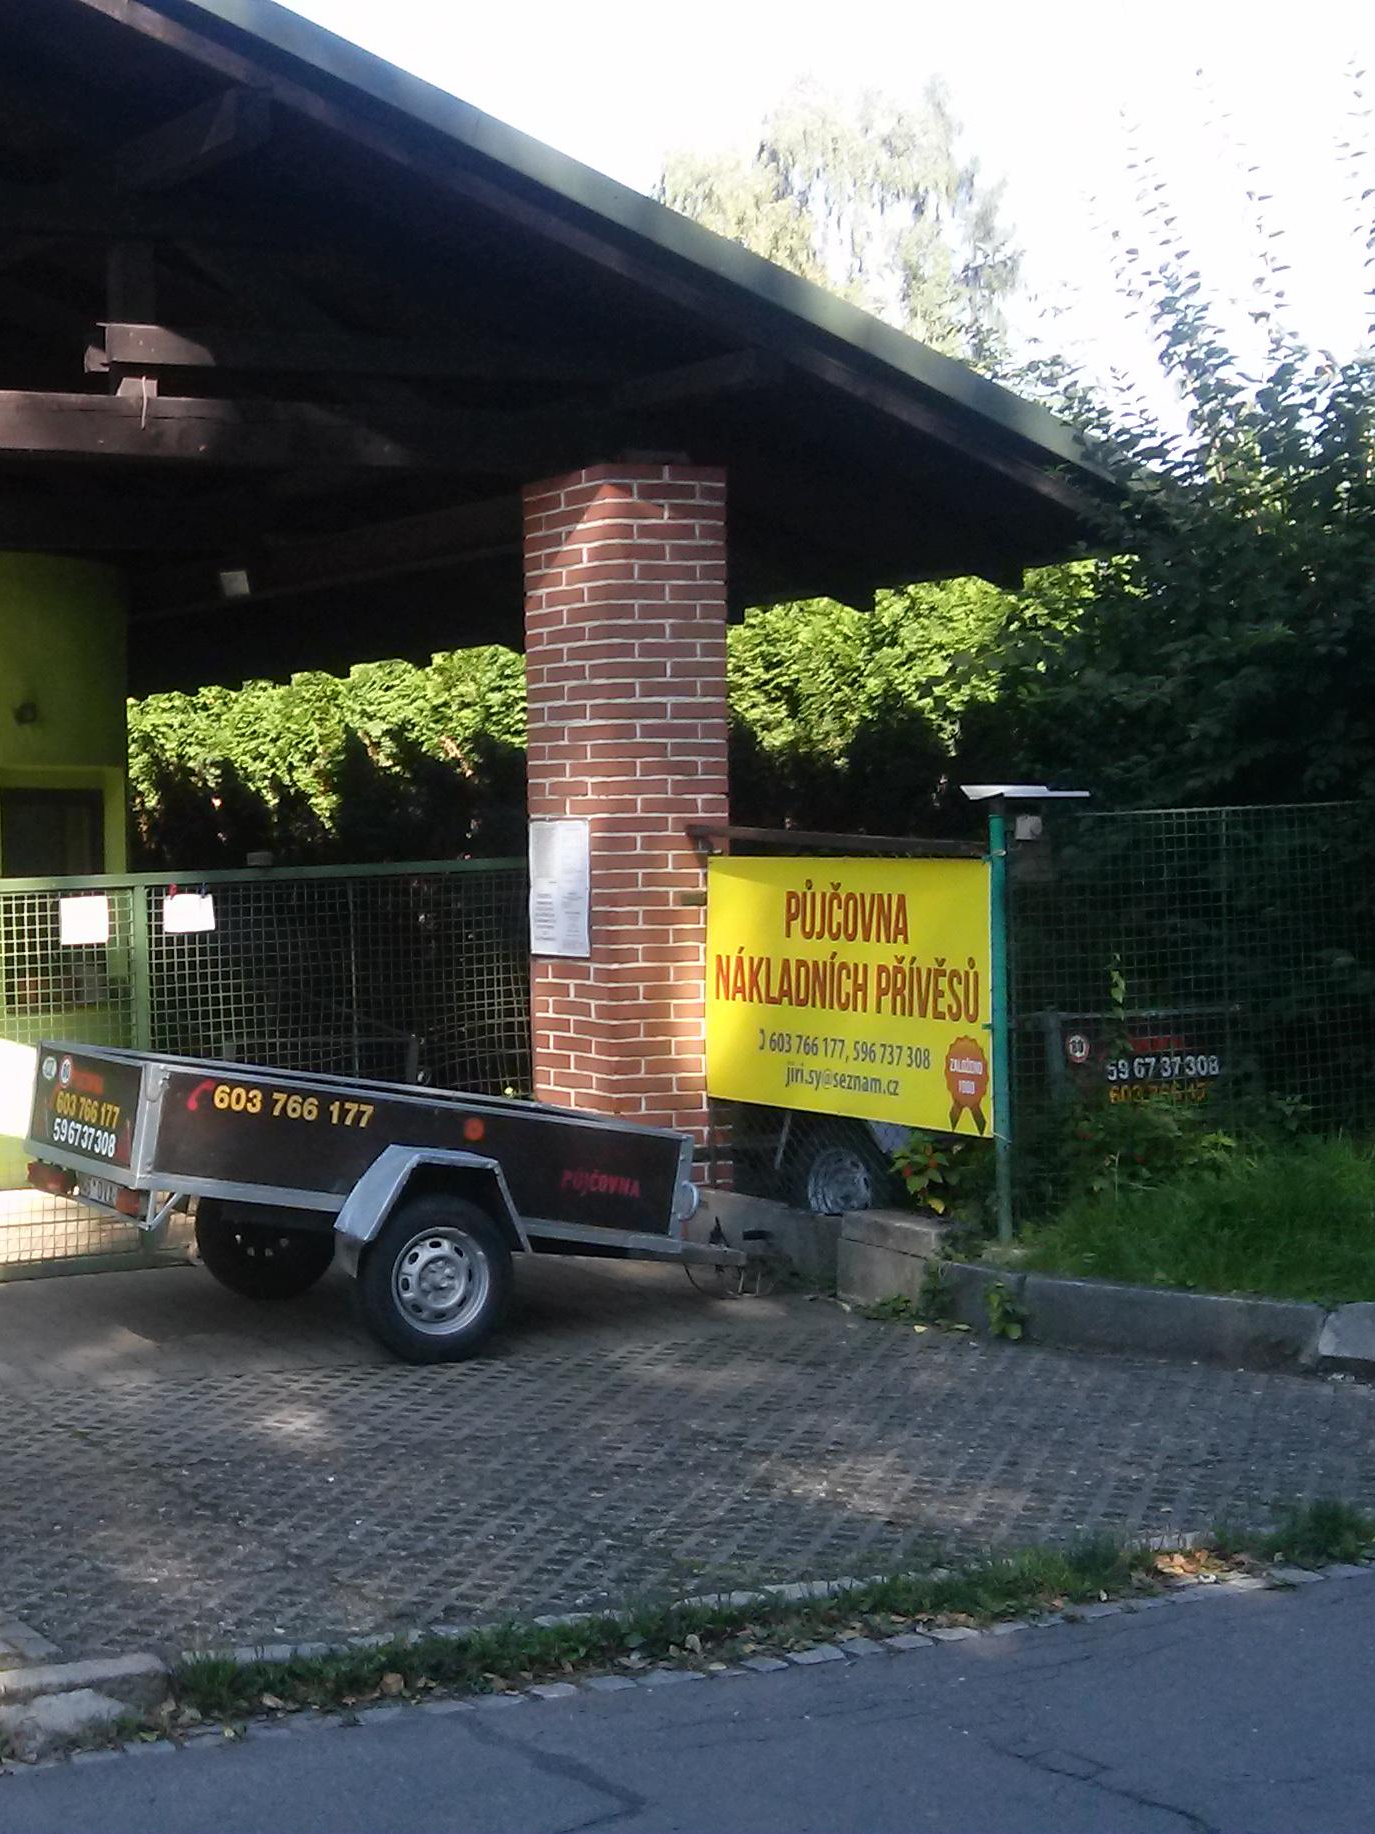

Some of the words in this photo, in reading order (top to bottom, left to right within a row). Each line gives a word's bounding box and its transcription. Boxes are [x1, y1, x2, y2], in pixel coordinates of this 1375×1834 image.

[785, 879, 909, 944] PŮJČOVNA
[715, 946, 869, 1013] NÁKLADNÍCH
[876, 954, 979, 1023] PŘÍVĚSŮ
[769, 1032, 792, 1054] 603
[796, 1035, 819, 1056] 766
[822, 1037, 850, 1063] 177,
[853, 1040, 876, 1062] 596
[880, 1043, 902, 1066] 737
[906, 1047, 931, 1070] 308
[1106, 1059, 1129, 1082] 59
[1133, 1056, 1156, 1079] 67
[1160, 1055, 1181, 1078] 37
[1185, 1054, 1220, 1077] 308
[56, 1092, 76, 1117] 603
[79, 1096, 99, 1124] 766
[100, 1102, 120, 1129] 177
[213, 1084, 263, 1114] 603
[272, 1092, 319, 1121] 766
[329, 1100, 375, 1128] 177
